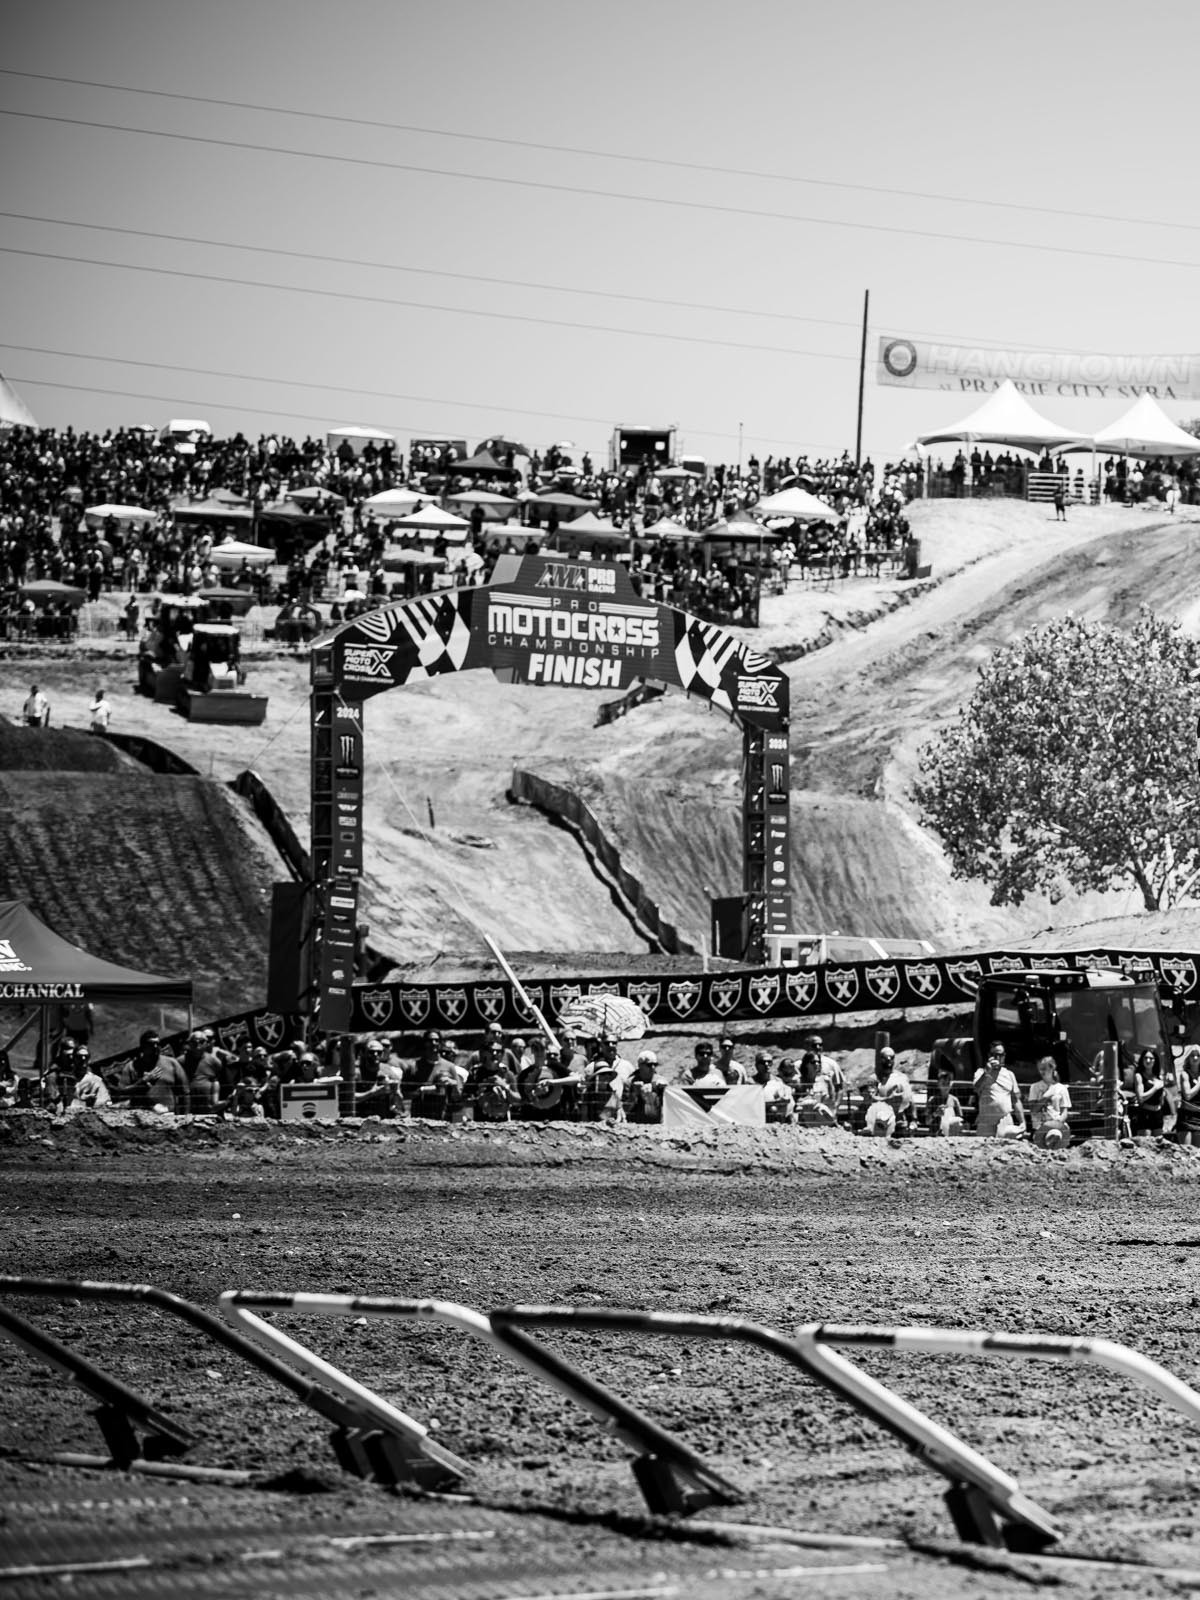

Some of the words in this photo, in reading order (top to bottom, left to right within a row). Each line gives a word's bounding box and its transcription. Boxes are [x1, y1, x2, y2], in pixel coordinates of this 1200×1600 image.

[960, 378, 1048, 395] PRARIE
[1057, 383, 1109, 398] CITY
[535, 563, 587, 592] AMA
[588, 567, 616, 585] PRO
[553, 598, 597, 612] PRO
[488, 605, 660, 647] MOTOCROSS
[488, 634, 660, 658] CHAMPIONSHIP
[528, 653, 622, 687] FINISH
[336, 706, 360, 719] 2024
[917, 976, 935, 992] X
[1171, 970, 1190, 986] X
[795, 985, 810, 1002] X
[835, 981, 852, 998] X
[876, 978, 894, 995] X
[676, 993, 692, 1009] X
[717, 992, 732, 1008] X
[757, 988, 771, 1005] X
[371, 1002, 386, 1017] X
[408, 1001, 423, 1016] X
[446, 1000, 459, 1015] X
[484, 1000, 498, 1015] X
